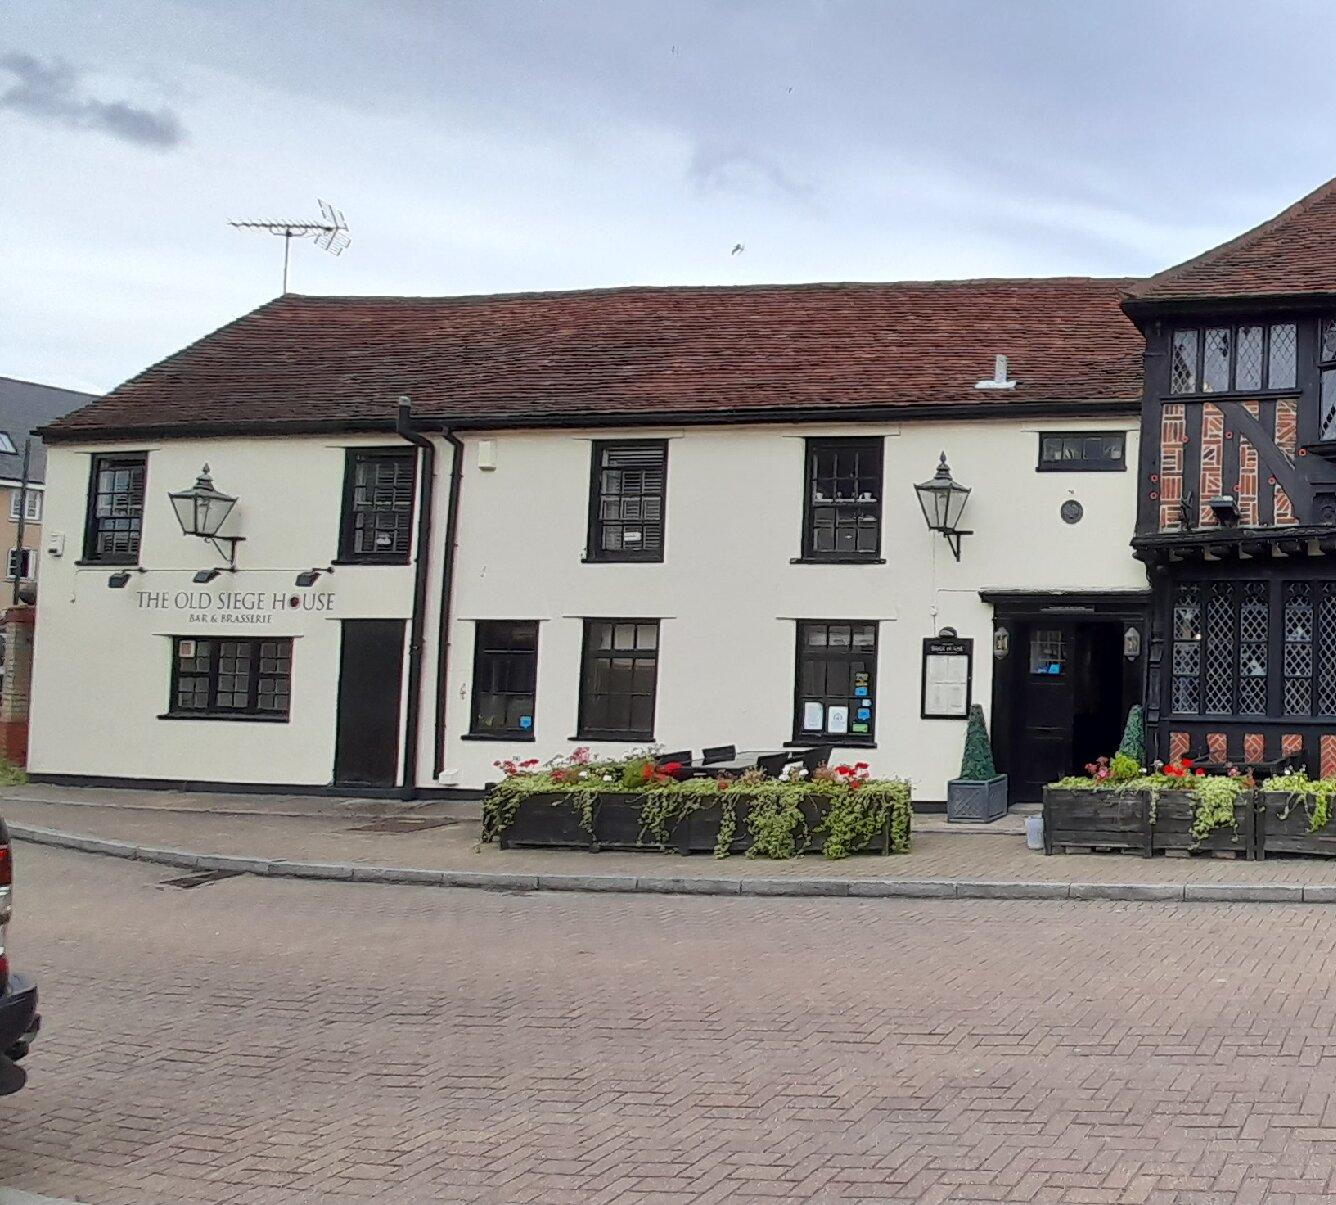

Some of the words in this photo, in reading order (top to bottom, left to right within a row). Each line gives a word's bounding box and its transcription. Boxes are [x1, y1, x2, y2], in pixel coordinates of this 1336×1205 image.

[136, 592, 170, 609] THE
[174, 592, 212, 610] OLD
[217, 592, 265, 610] SIEGE
[272, 592, 336, 611] HOUSE
[189, 614, 208, 623] BAR
[210, 614, 218, 623] &
[220, 614, 273, 624] BRASSERIE
